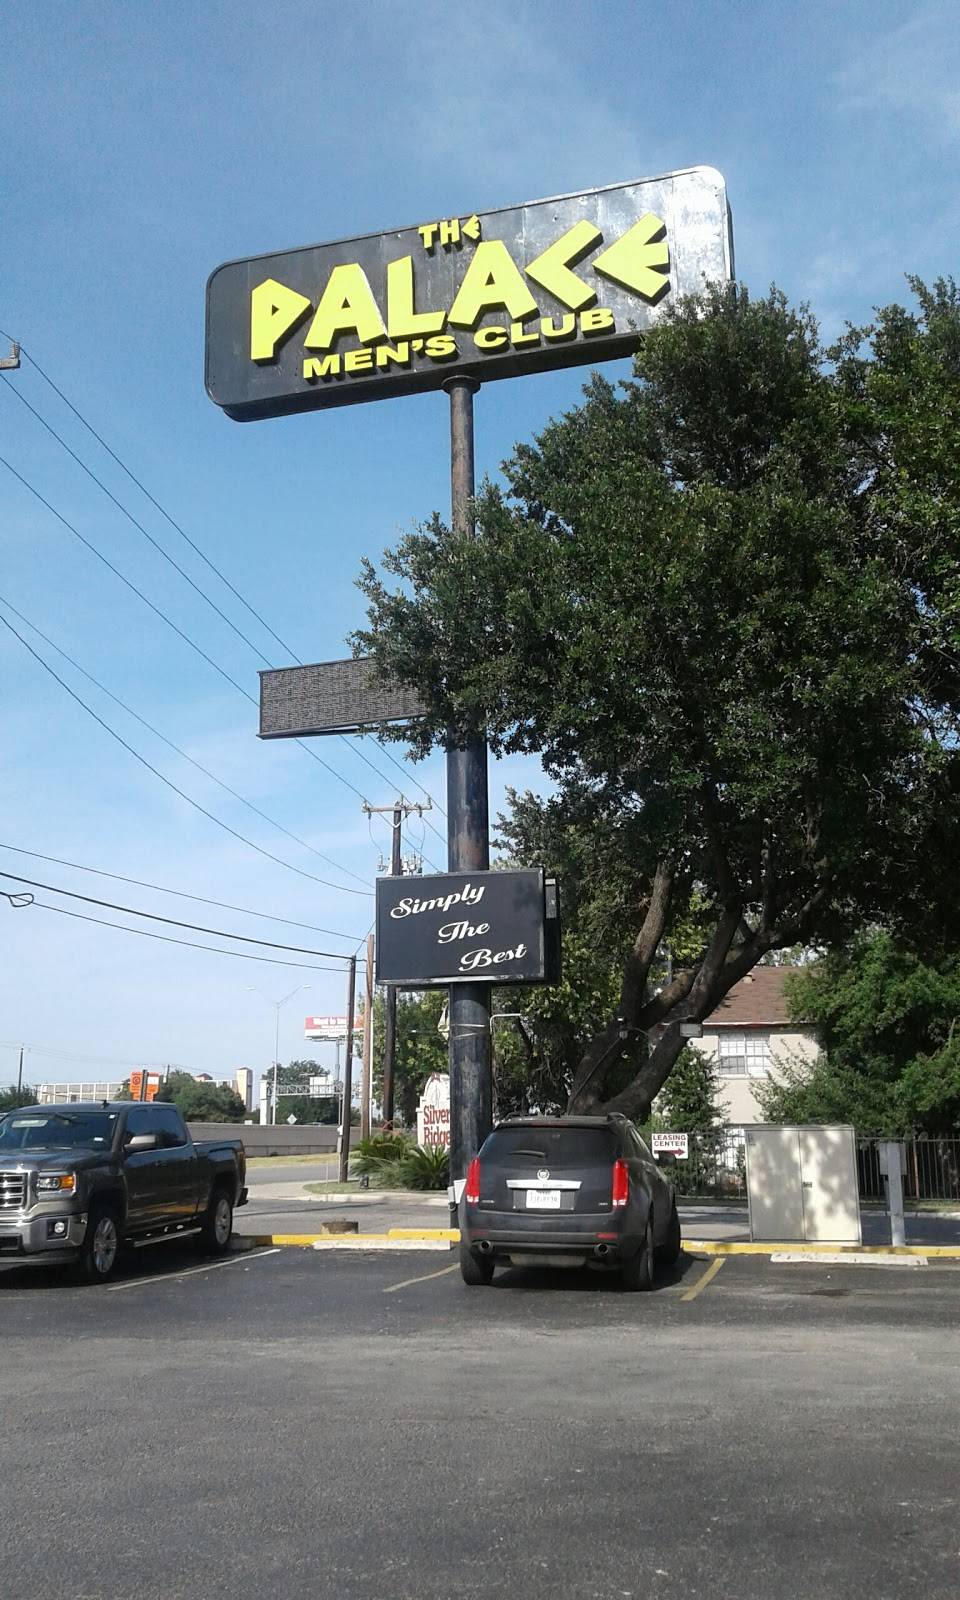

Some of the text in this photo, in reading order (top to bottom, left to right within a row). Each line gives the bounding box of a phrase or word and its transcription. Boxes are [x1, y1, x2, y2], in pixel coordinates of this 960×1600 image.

[419, 214, 481, 251] THE
[250, 212, 670, 362] PALACE
[302, 307, 615, 380] MEN'S CLUB
[389, 883, 486, 919] Simply
[437, 919, 491, 944] The
[458, 943, 527, 972] Best
[423, 1104, 449, 1125] Silver
